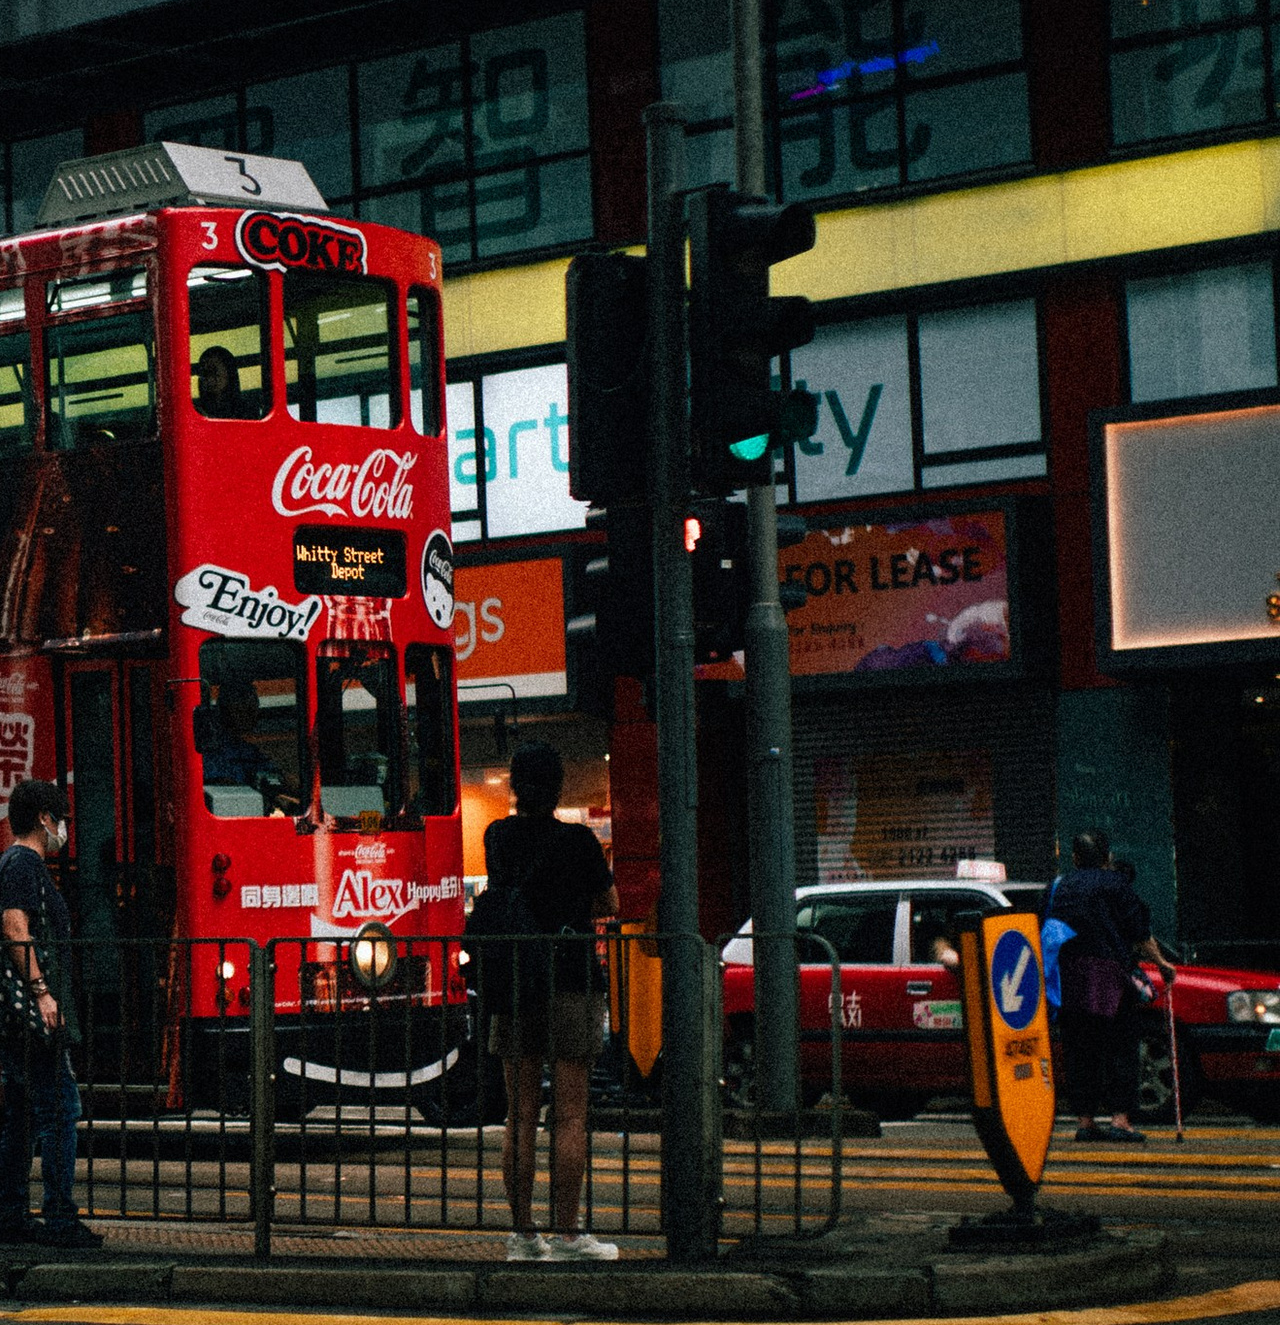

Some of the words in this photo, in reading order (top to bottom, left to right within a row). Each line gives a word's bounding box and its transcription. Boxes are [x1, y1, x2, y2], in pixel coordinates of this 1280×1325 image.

[225, 156, 262, 196] 3
[201, 222, 219, 251] 3
[249, 218, 361, 273] COKE
[428, 252, 437, 280] 3
[455, 401, 570, 486] art
[272, 445, 416, 520] Coca-Cola
[296, 544, 339, 565] Whitty
[344, 547, 385, 564] Street
[330, 563, 366, 581] Depot
[784, 560, 858, 596] FOR
[870, 546, 983, 591] LEASE
[198, 569, 318, 638] Enjoy!
[454, 595, 506, 659] gs
[335, 873, 404, 914] Alex
